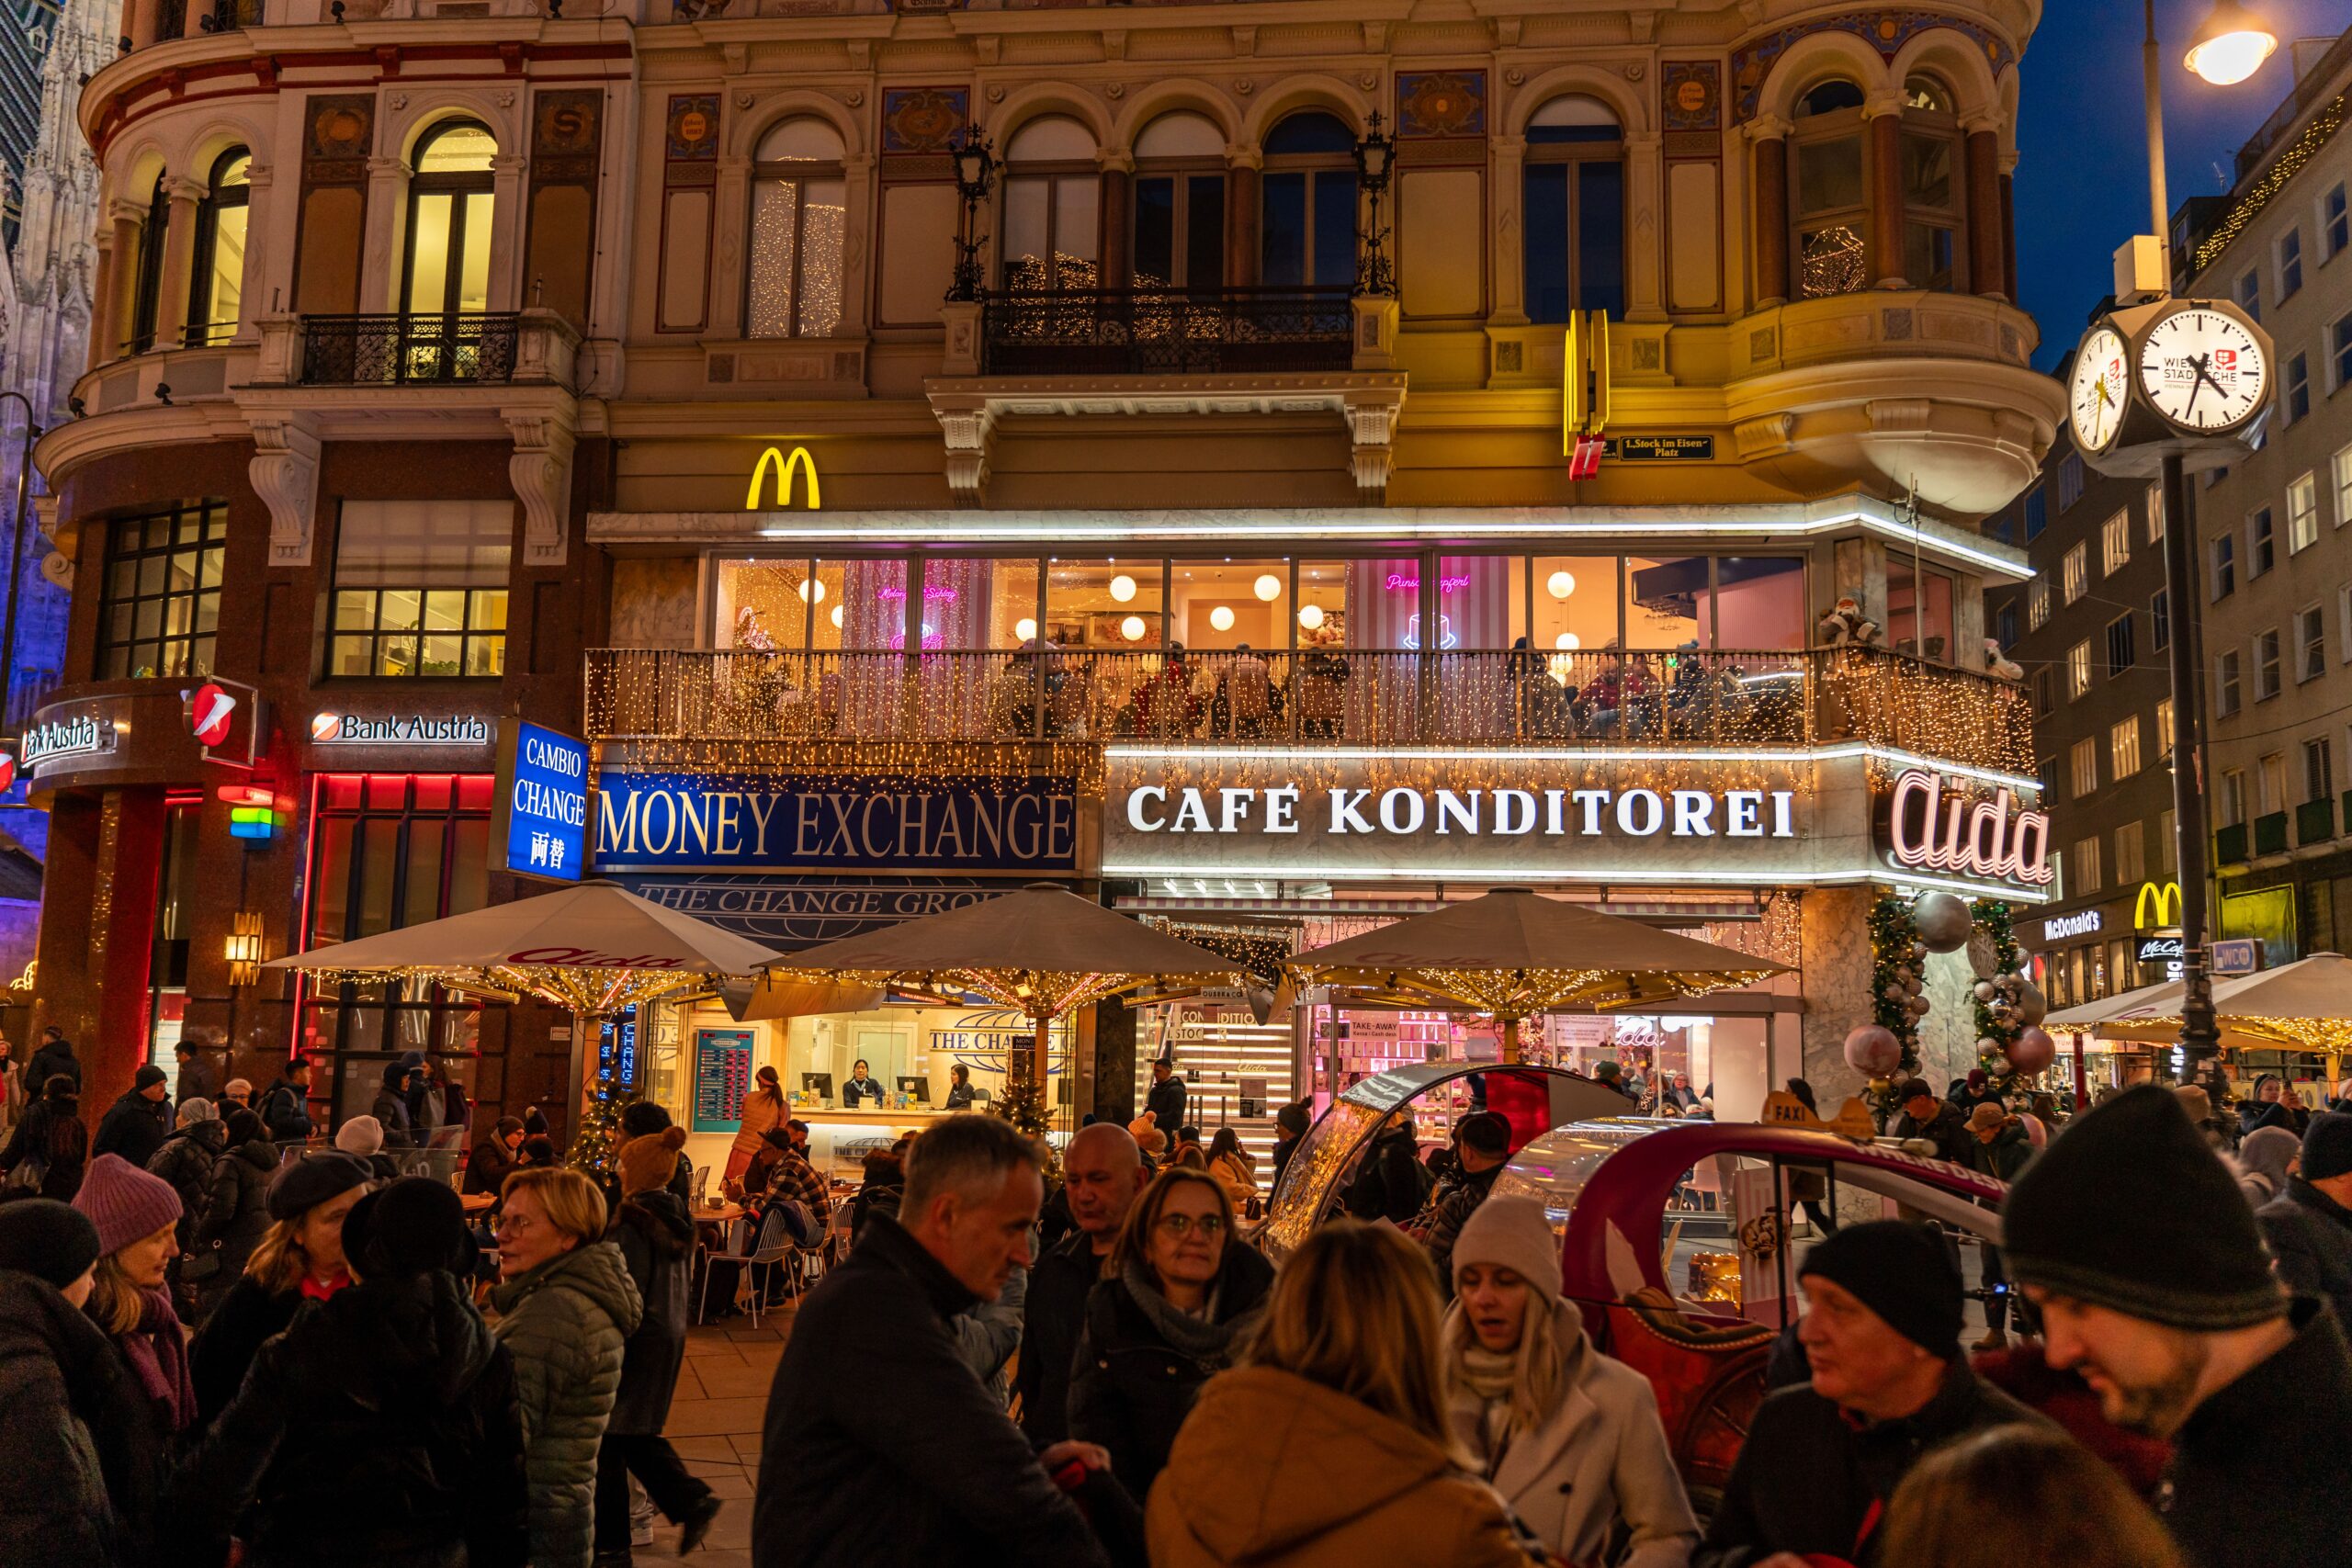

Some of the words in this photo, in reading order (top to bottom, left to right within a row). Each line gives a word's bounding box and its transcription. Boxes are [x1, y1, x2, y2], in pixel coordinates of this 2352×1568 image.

[2165, 357, 2212, 369] WIER
[2165, 368, 2237, 382] STÄDCHE
[1655, 448, 1679, 457] Platz
[1663, 439, 1675, 448] im
[1677, 439, 1708, 448] Eisen-
[878, 588, 907, 602] Melang
[342, 715, 401, 739] Bank
[406, 715, 487, 739] Austria
[526, 738, 581, 778] CAMBIO
[514, 779, 585, 827] CHANGE
[1126, 782, 1299, 833] CAFÉ
[1328, 787, 1794, 838] KONDITOREI
[595, 790, 781, 855] MONEY
[792, 793, 1074, 859] EXCHANGE
[530, 830, 565, 870] 両替
[638, 886, 710, 909] THE
[718, 889, 882, 915] CHANGE
[893, 892, 1008, 916] GRO
[2044, 910, 2100, 941] McDonald's
[2141, 939, 2184, 958] McCaf
[929, 1032, 969, 1049] THE
[974, 1032, 1056, 1051] CHAE
[1176, 1029, 1203, 1040] STOC
[1775, 1105, 1806, 1121] FAXI
